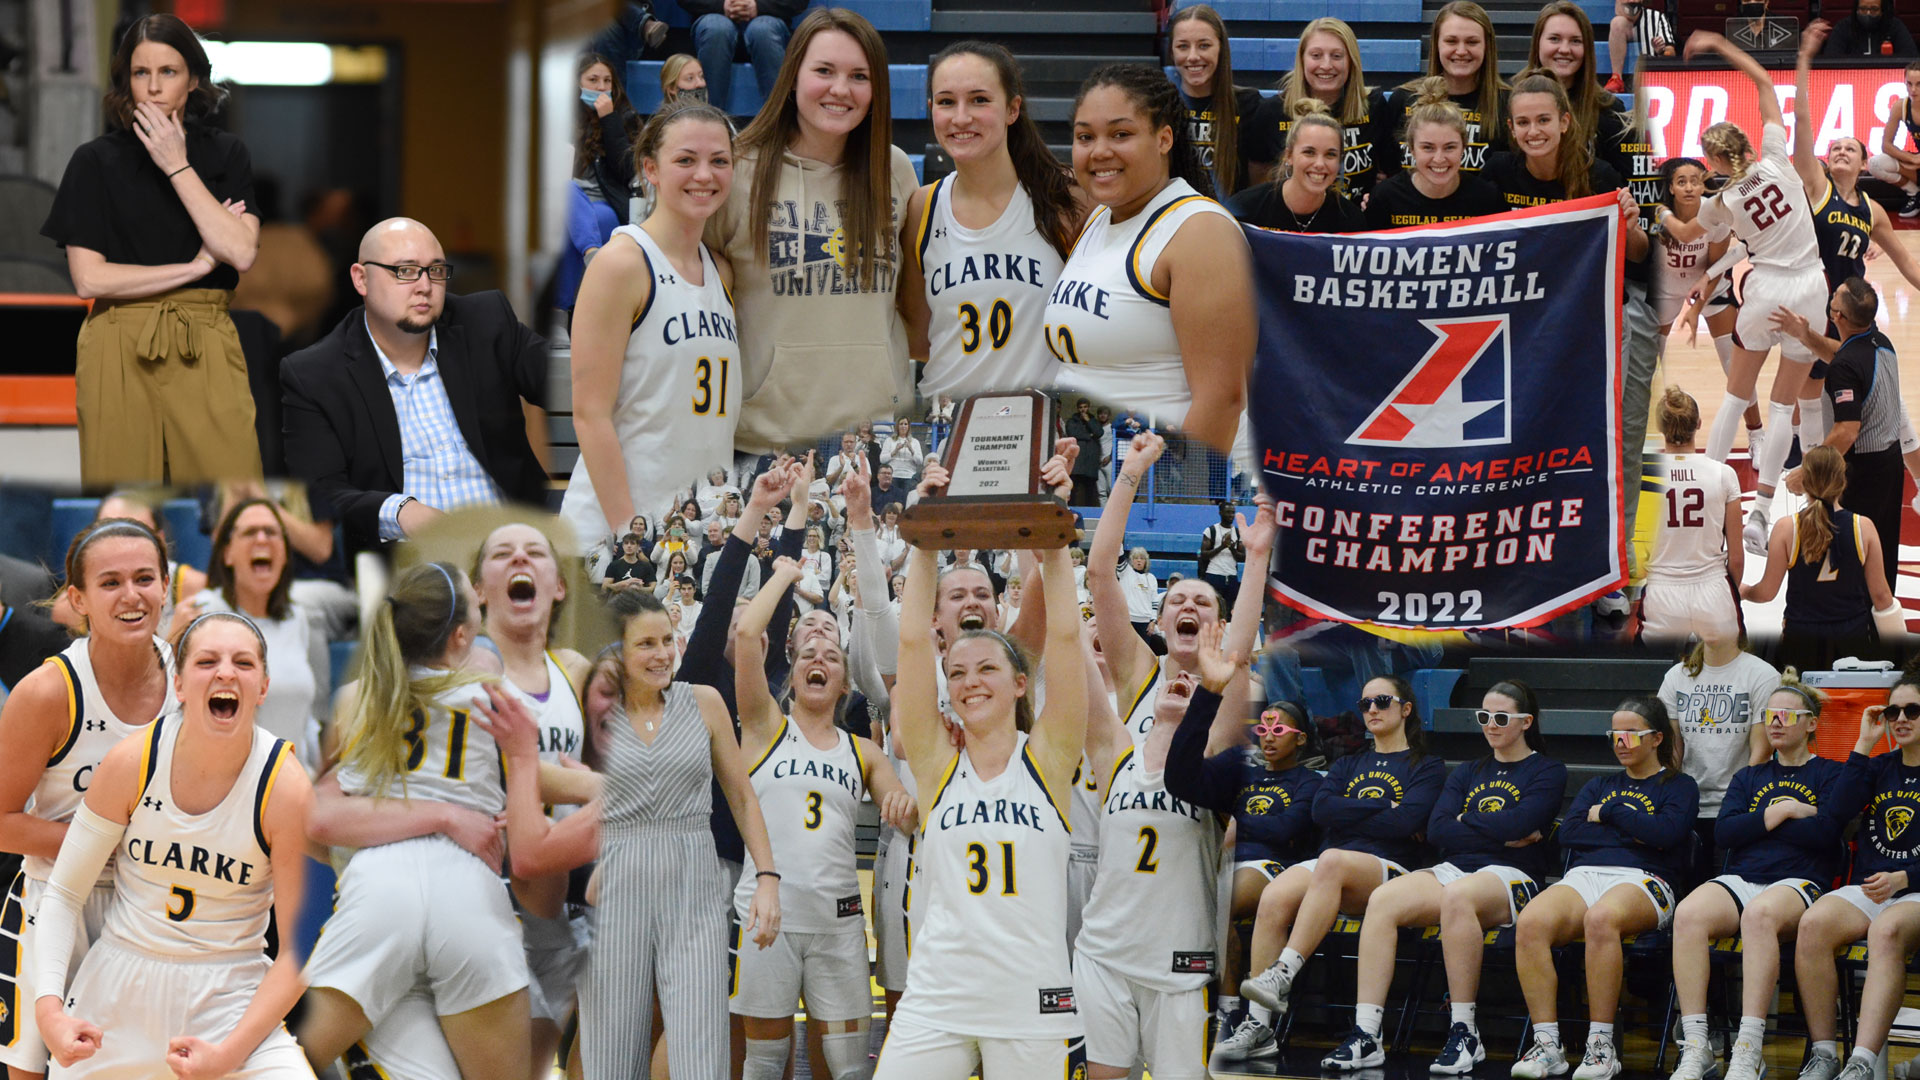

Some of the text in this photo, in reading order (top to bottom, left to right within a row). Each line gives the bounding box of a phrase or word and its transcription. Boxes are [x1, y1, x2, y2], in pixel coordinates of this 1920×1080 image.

[1504, 192, 1546, 207] EGULAR
[1738, 173, 1766, 196] BRINK
[1744, 184, 1792, 231] 22
[1332, 240, 1517, 276] WOMEN'S
[1667, 252, 1697, 268] 30
[1837, 230, 1862, 259] 22
[930, 253, 1044, 296] CLARKE
[1293, 271, 1546, 309] BASKETBALL
[958, 297, 1024, 355] 30
[692, 356, 729, 417] 31
[970, 434, 1024, 443] TOURNAMENT
[974, 443, 1018, 451] CHAMPION
[1263, 446, 1593, 482] HEART OF AMERICA
[1671, 469, 1696, 482] HULL
[1305, 472, 1548, 495] ATHLETIC CONFERENCE
[1275, 498, 1584, 542] CONFERENCE
[1666, 488, 1704, 528] 12
[1306, 533, 1556, 573] CHAMPION
[1377, 590, 1483, 622] 2022
[1694, 684, 1733, 693] CLARKE
[1676, 690, 1749, 723] PRIDE
[774, 758, 858, 799] CLARKE
[1779, 780, 1817, 805] UNIVERSI
[804, 791, 823, 830] 3
[940, 799, 1044, 832] CLARKE
[1109, 790, 1201, 823] CLARKE
[128, 838, 254, 886] CLARKE
[1134, 825, 1161, 875] 2
[1875, 841, 1908, 859] BETTER
[966, 841, 1018, 896] 31
